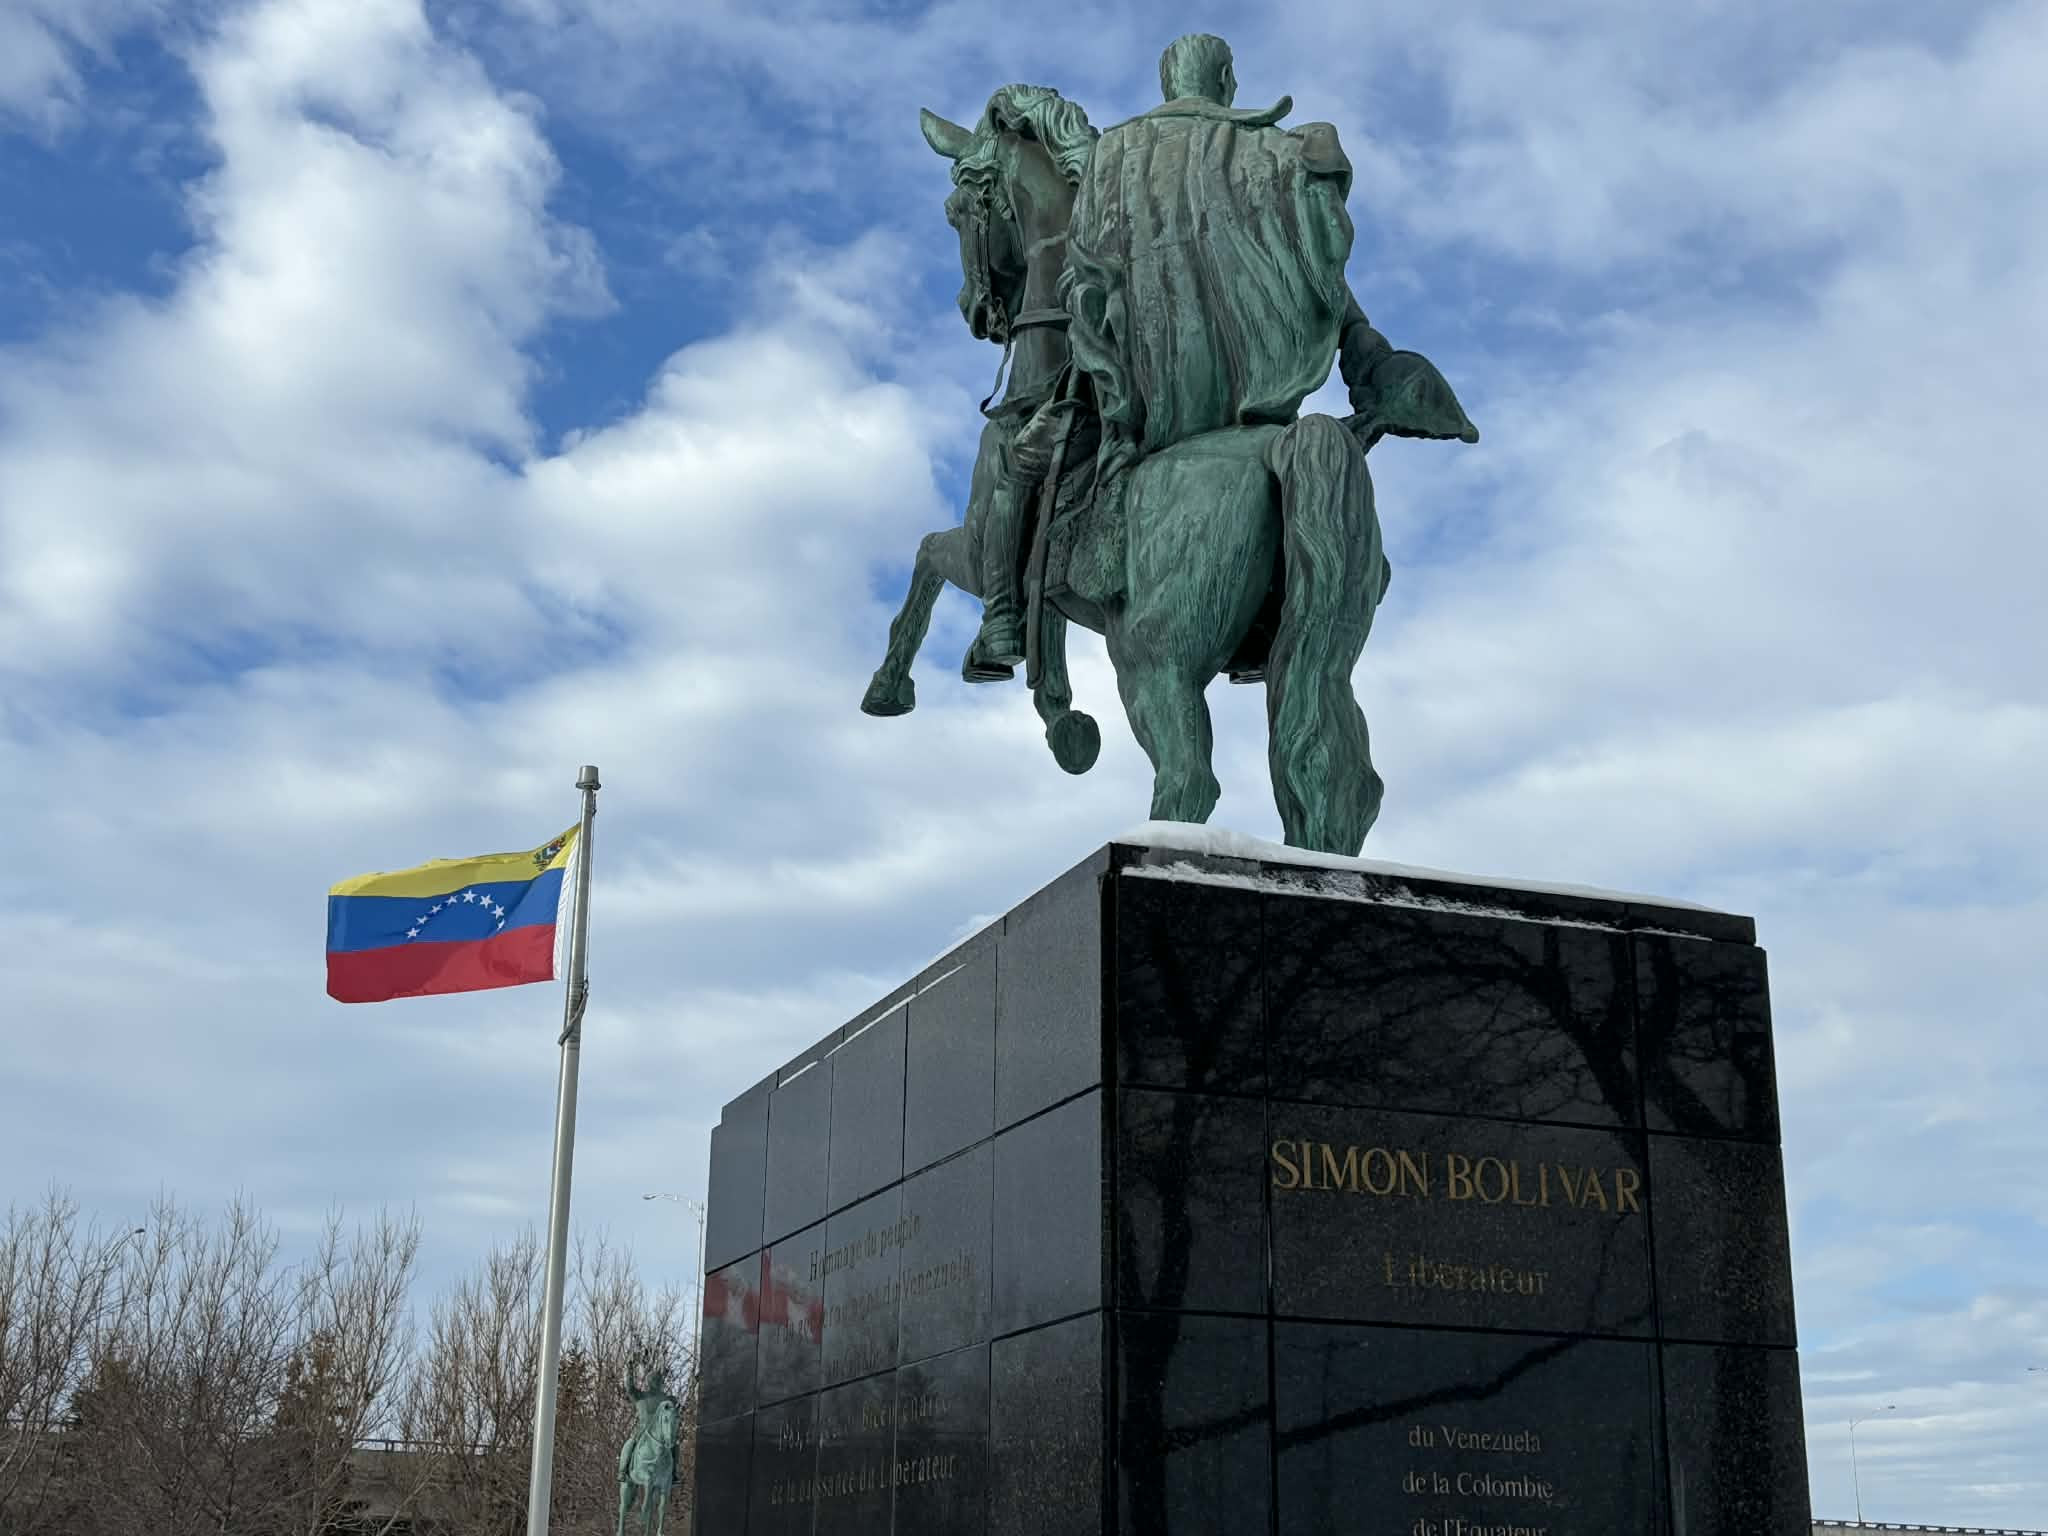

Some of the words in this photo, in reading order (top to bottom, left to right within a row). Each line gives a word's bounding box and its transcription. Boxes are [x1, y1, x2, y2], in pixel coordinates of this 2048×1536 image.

[1271, 1138, 1433, 1199] SIMON
[1446, 1151, 1643, 1214] BOLIVAR
[1407, 1424, 1435, 1449] du
[1440, 1425, 1543, 1454] Venezuela
[1401, 1471, 1427, 1495] de
[1432, 1471, 1450, 1495] la
[1455, 1472, 1554, 1499] Colombie
[1412, 1517, 1438, 1536] de
